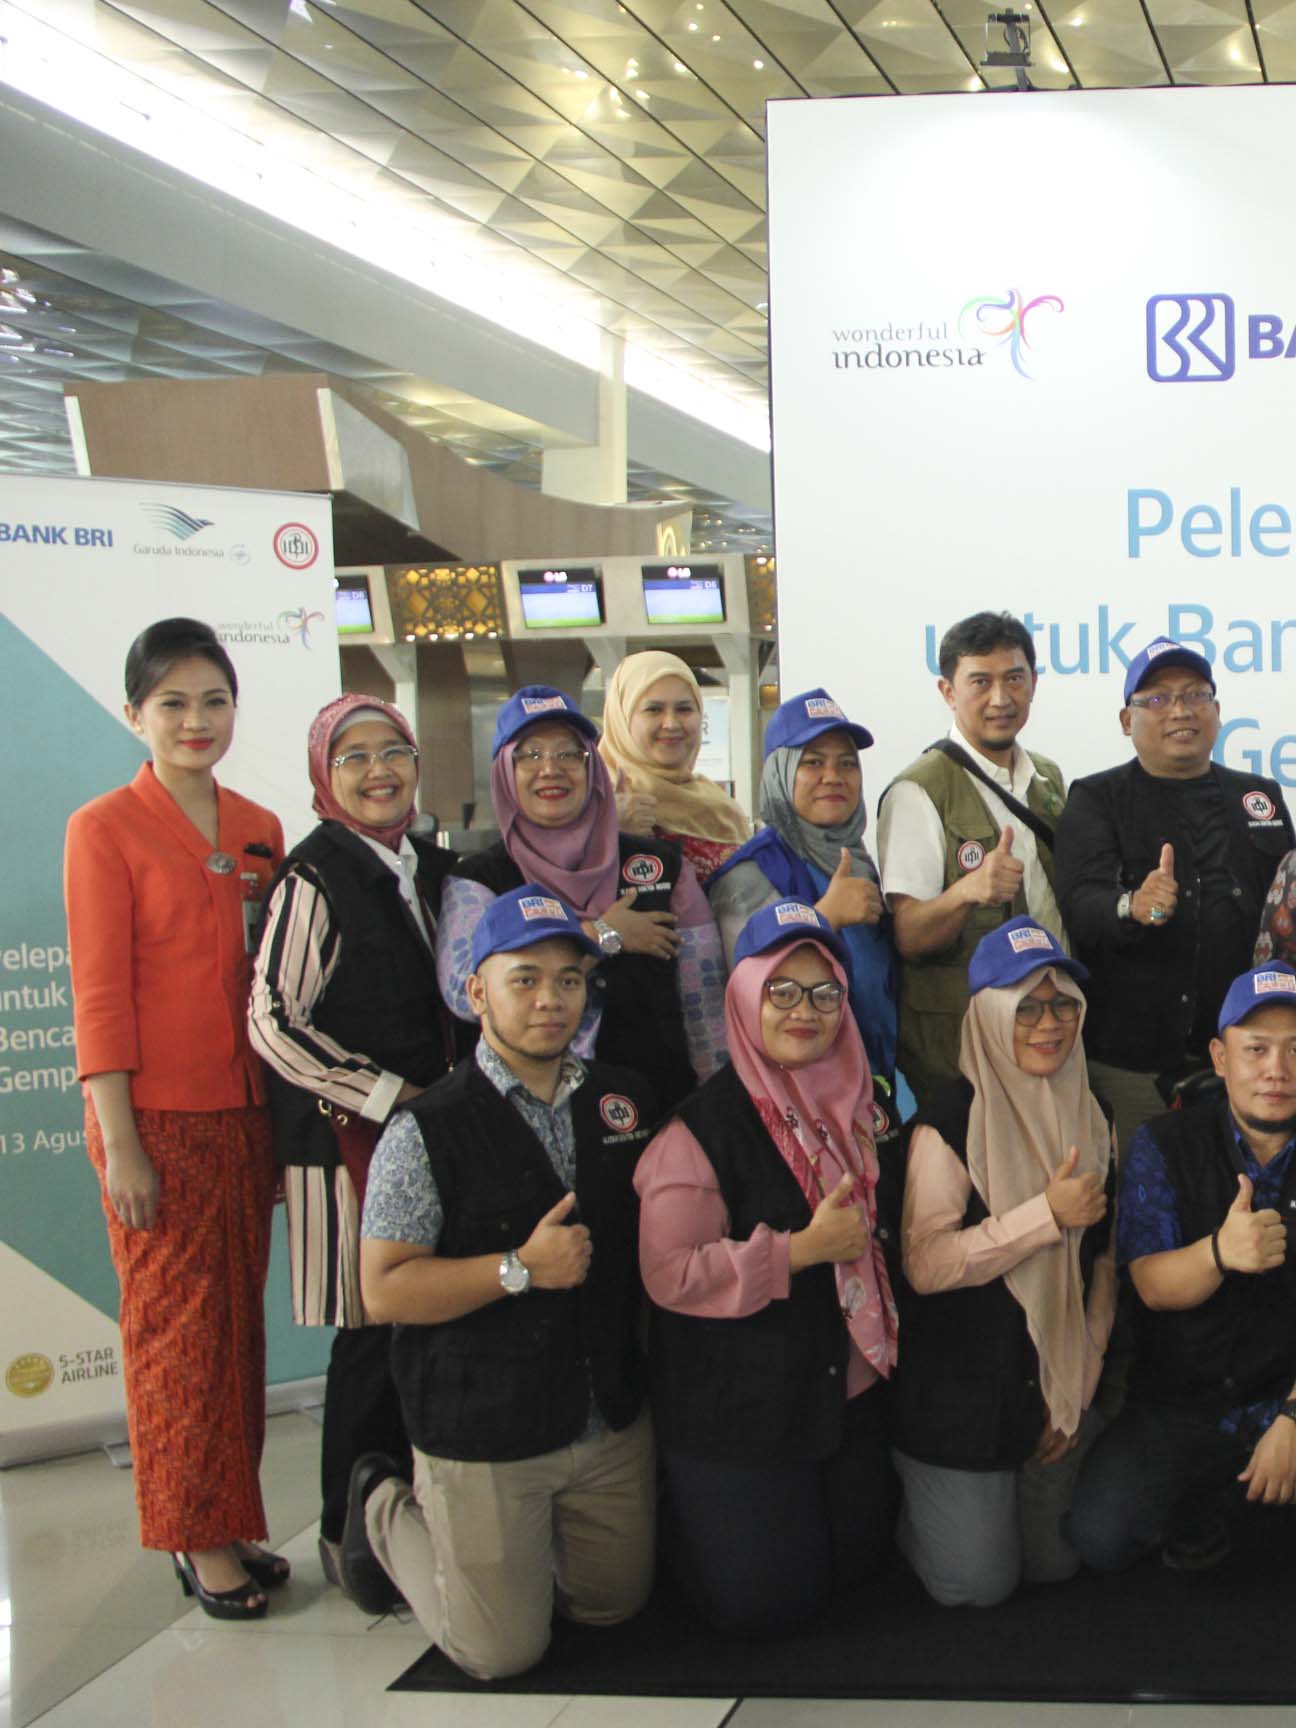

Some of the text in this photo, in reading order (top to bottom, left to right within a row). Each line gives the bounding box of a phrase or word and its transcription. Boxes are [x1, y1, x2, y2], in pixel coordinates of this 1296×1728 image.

[832, 322, 948, 343] wonderful
[832, 343, 986, 369] indonesia
[0, 523, 114, 547] BANK BRI
[133, 543, 225, 559] Garuda Indonesia
[925, 604, 1137, 675] utuk
[0, 980, 68, 1011] ntuk
[59, 1346, 114, 1369] 5-STAR
[61, 1361, 119, 1385] AIRLINE
